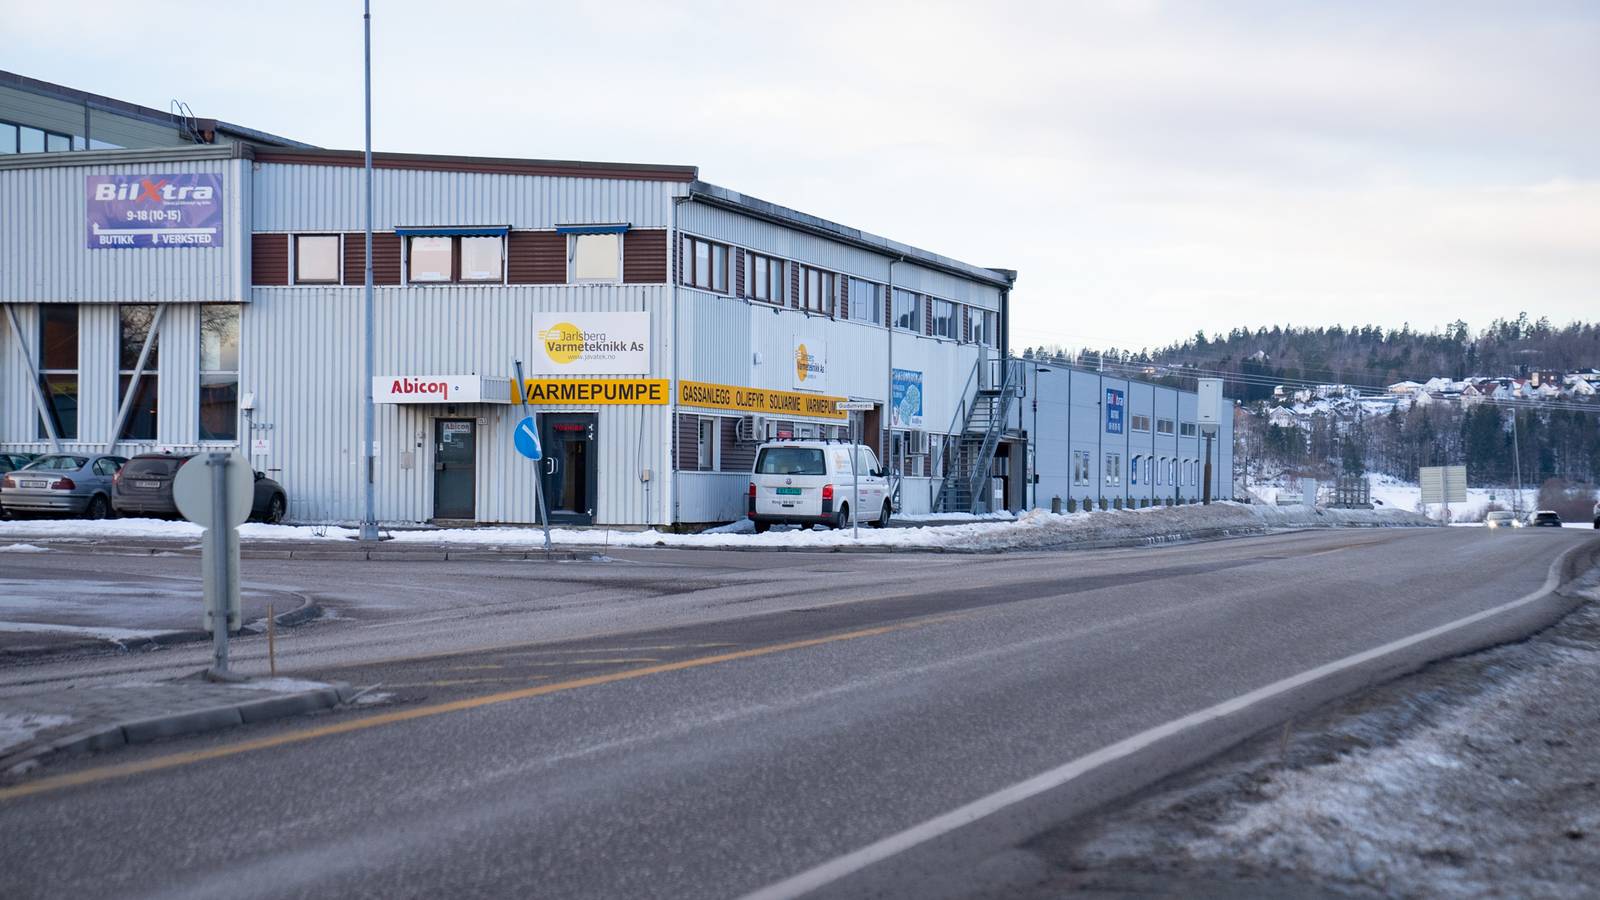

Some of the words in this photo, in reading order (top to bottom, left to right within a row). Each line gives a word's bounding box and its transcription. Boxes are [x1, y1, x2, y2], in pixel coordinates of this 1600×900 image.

[95, 179, 213, 202] BilXtra
[126, 210, 147, 221] 9-18
[149, 209, 182, 223] (10-15)
[99, 235, 135, 245] BUTIKK
[162, 234, 212, 244] VERKSTED
[561, 331, 606, 343] Jarlsberg
[547, 341, 627, 352] Varmeteknikk
[630, 341, 644, 352] As
[391, 378, 448, 400] Abicon
[682, 385, 730, 405] GASSANLEGG
[736, 390, 764, 408] OLJEFYR
[769, 393, 800, 411] SOLVARME
[805, 398, 843, 415] VARMEPUM
